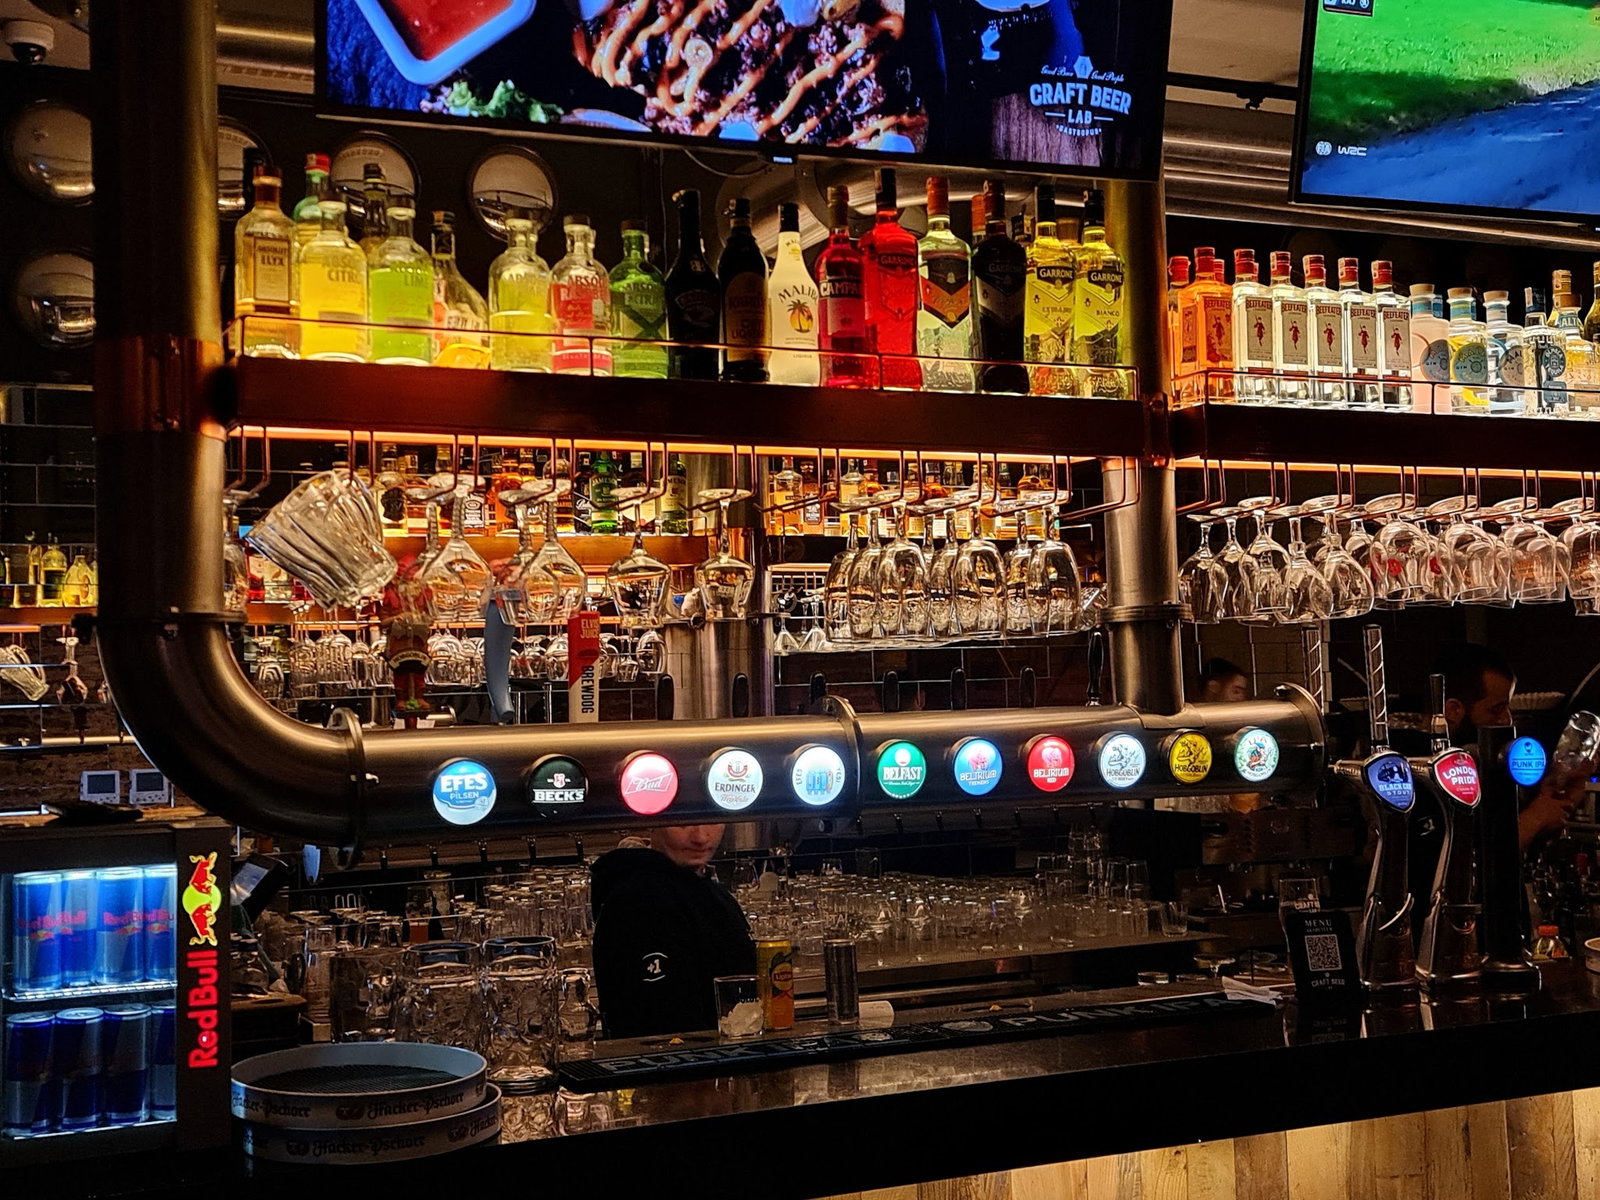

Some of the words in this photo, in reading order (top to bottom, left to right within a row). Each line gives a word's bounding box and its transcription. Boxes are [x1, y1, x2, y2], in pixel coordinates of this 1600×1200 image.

[1030, 82, 1088, 106] CRAFT
[1090, 84, 1132, 115] BEER
[1068, 109, 1092, 124] LAB
[1338, 144, 1367, 156] WRC
[1039, 267, 1073, 280] GARRONE
[1090, 272, 1123, 284] GARRONE
[1204, 299, 1231, 310] BEEFEATER
[1246, 300, 1272, 310] BEEFEATER
[1281, 303, 1307, 313] BEEFEATER
[1096, 309, 1120, 318] BIANCO
[1316, 306, 1342, 316] BEEFEATER
[1350, 308, 1376, 319] BEEFEATER
[1383, 310, 1409, 320] BEEFEATER
[581, 618, 599, 629] ELVIS
[581, 629, 599, 639] JUICE
[581, 665, 595, 714] BREWDOG
[1175, 764, 1208, 773] HOBGOBLIN
[1511, 760, 1533, 768] PUNK
[883, 766, 922, 780] BELFAST
[960, 770, 998, 782] DELIRIUM
[1033, 767, 1070, 778] DELIRIUM
[1106, 768, 1140, 777] HOBGOBLIN
[1442, 765, 1477, 779] LONDON
[440, 773, 488, 793] EFES
[635, 777, 663, 790] Bud
[1451, 776, 1476, 785] PRIDE
[715, 782, 756, 794] ERDINGER
[1379, 783, 1402, 791] BLACK
[534, 790, 584, 802] BECK'S
[1304, 919, 1332, 927] MENU
[187, 950, 219, 1007] Bull
[187, 1010, 219, 1068] Red
